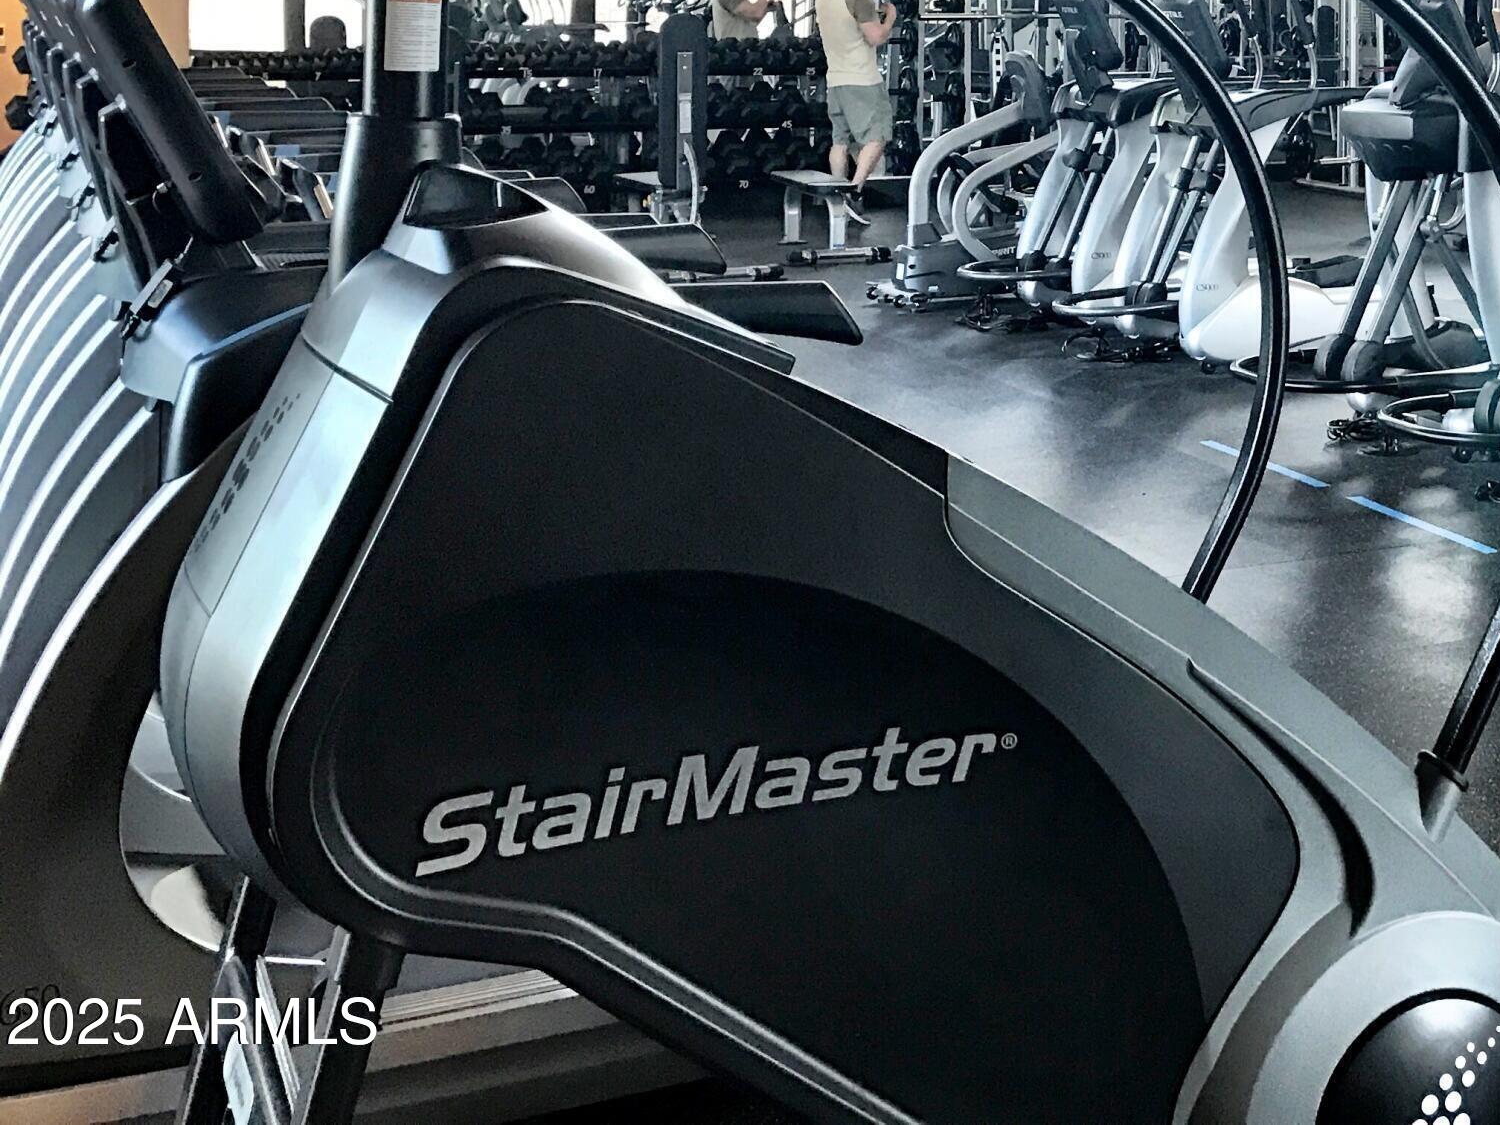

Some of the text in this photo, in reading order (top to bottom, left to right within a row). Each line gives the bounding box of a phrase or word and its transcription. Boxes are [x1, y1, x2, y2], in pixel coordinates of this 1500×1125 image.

[752, 67, 764, 76] 22
[781, 120, 793, 129] 45
[738, 179, 749, 189] 70
[583, 185, 595, 194] 60
